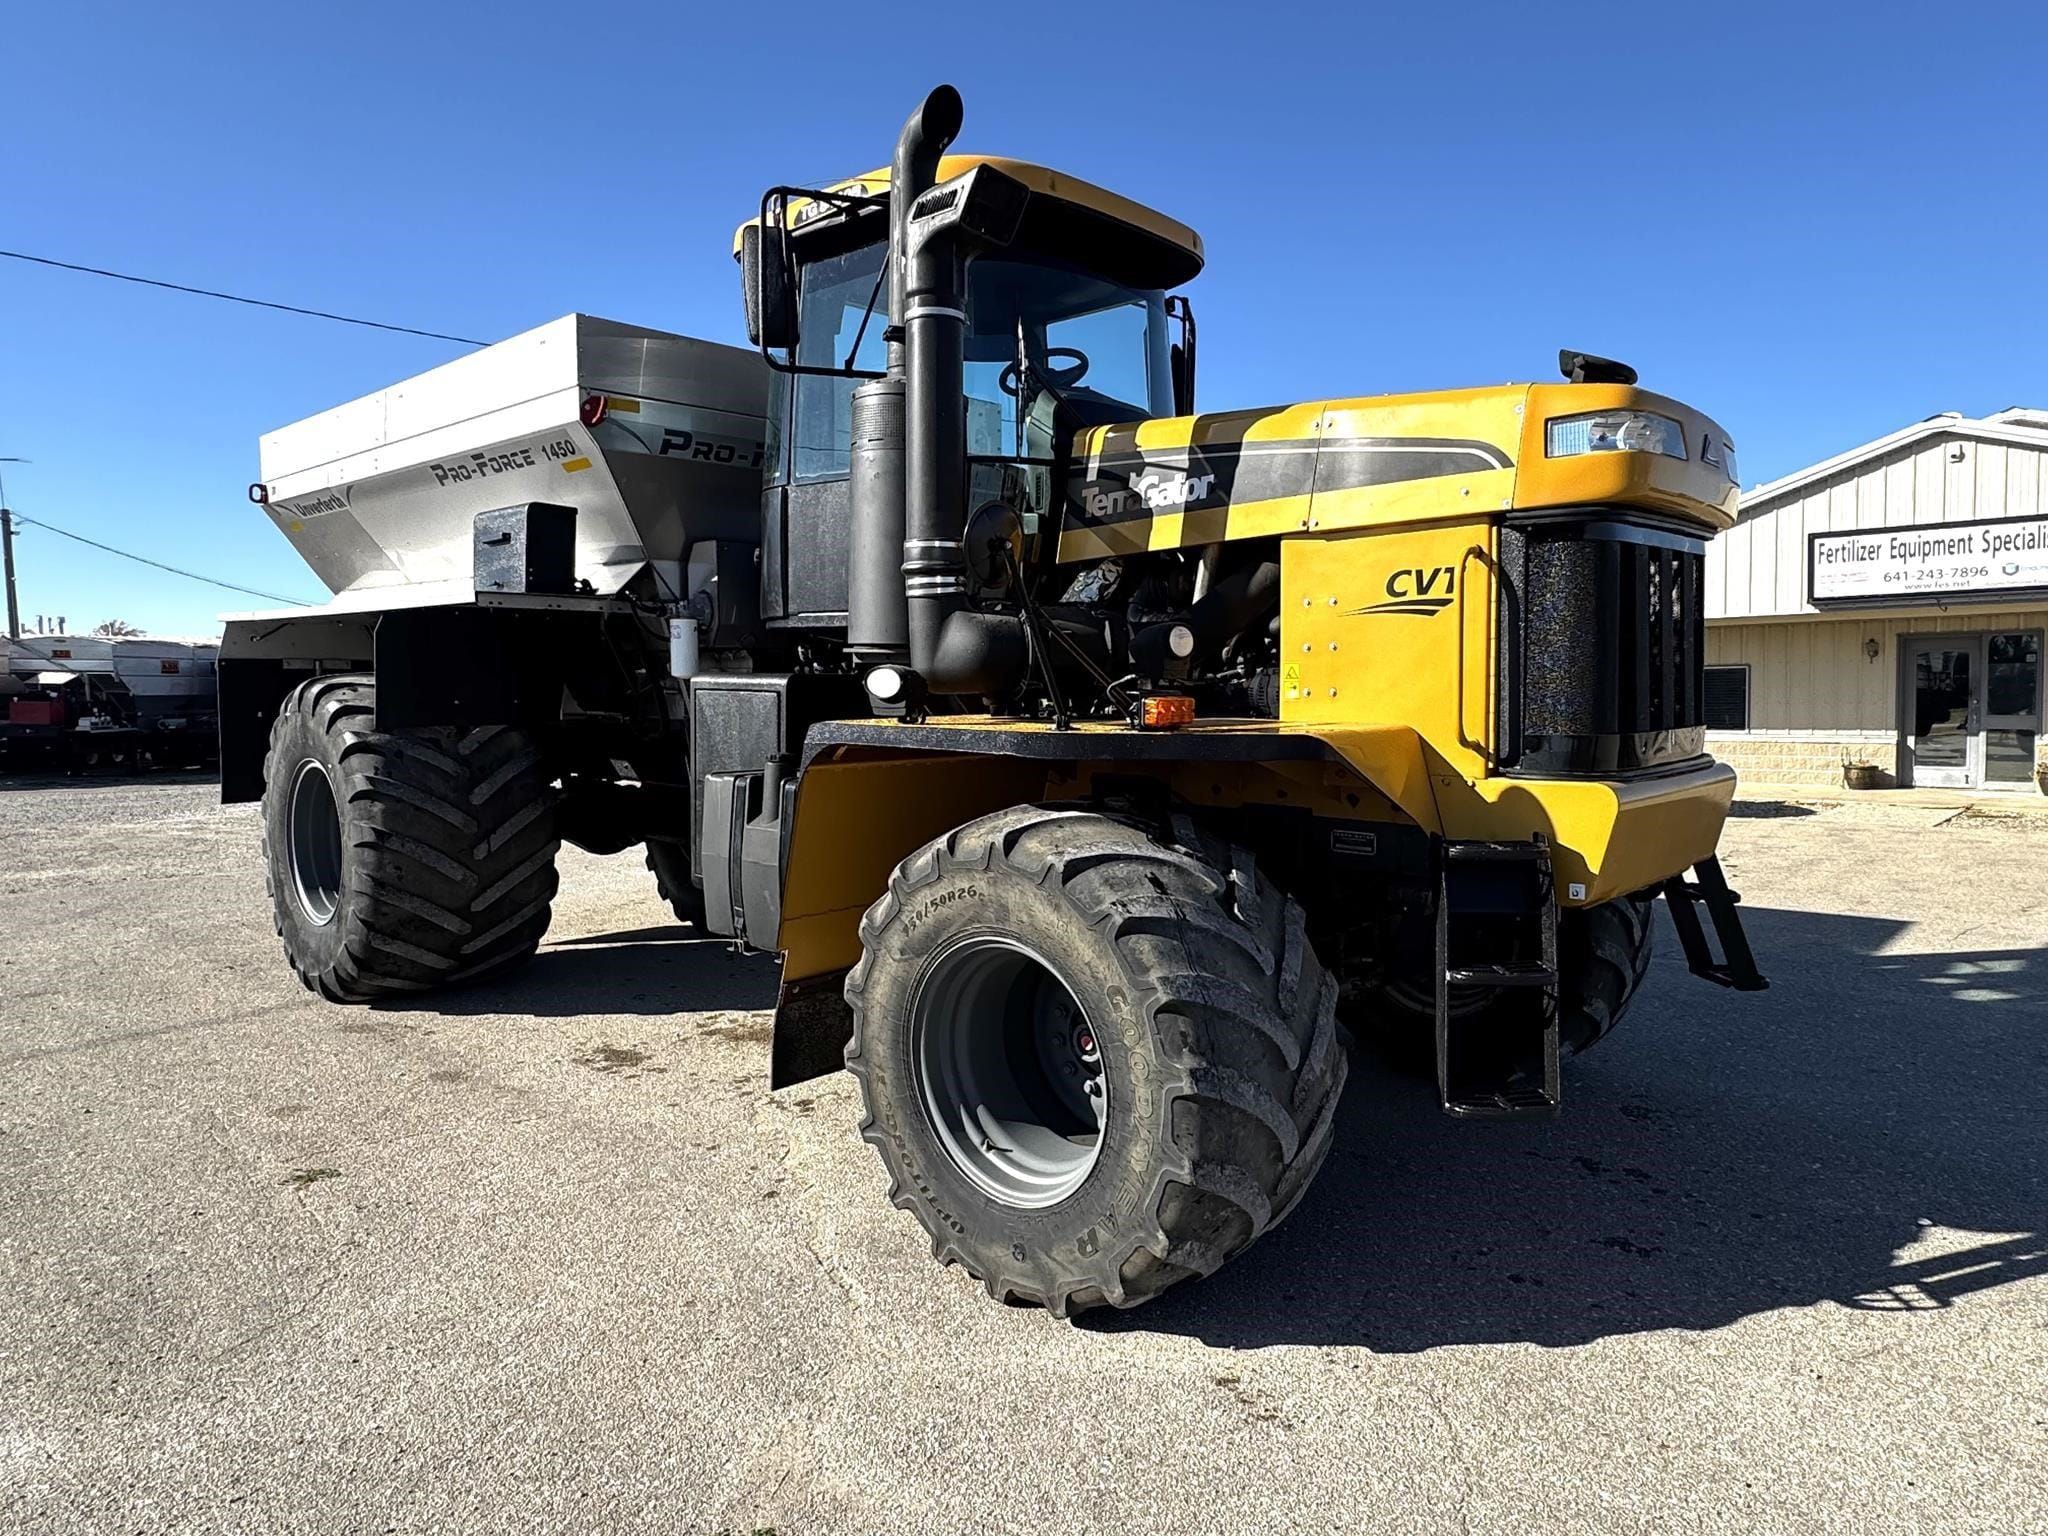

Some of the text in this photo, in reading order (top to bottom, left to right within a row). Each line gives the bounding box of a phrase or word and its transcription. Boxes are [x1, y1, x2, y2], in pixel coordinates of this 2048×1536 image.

[541, 439, 576, 461] 1450
[1818, 525, 2048, 565] Fertilizer Equipment Speciali
[1884, 566, 1989, 582] 641-243-7896
